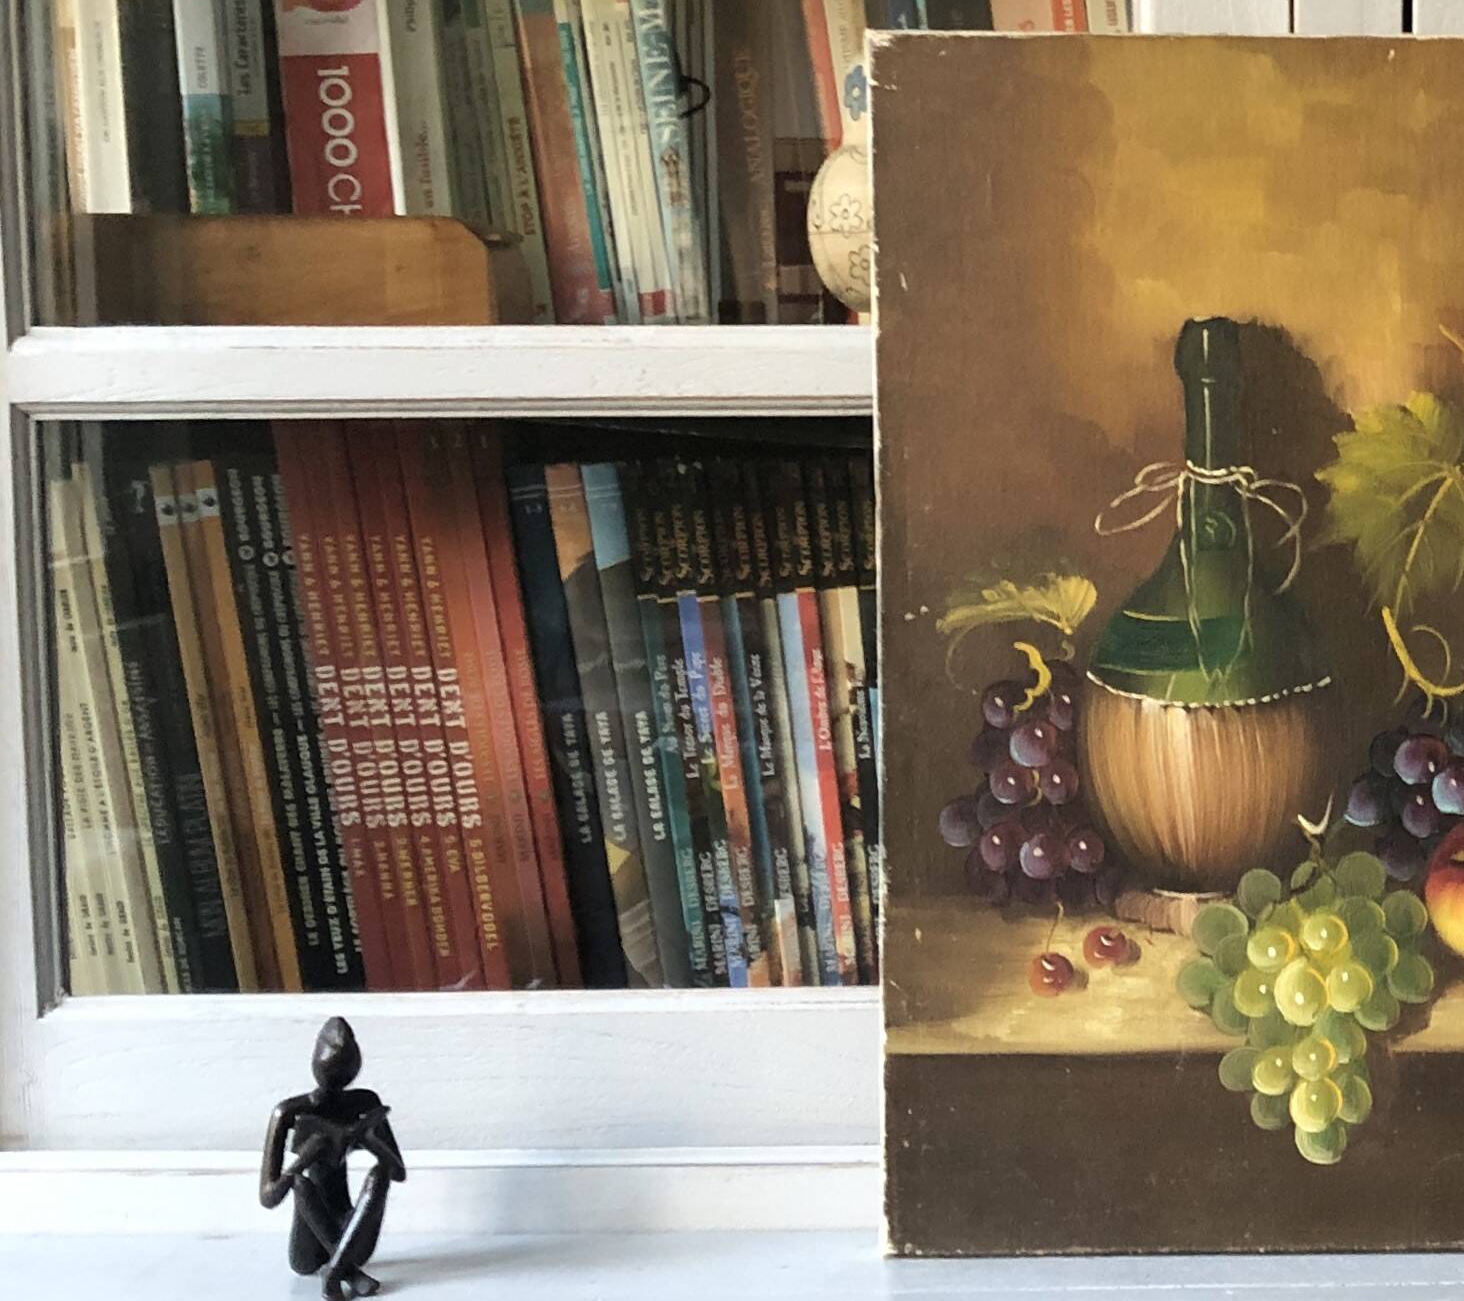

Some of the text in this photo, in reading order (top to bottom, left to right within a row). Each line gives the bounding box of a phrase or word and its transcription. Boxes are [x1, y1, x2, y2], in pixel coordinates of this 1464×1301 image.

[195, 46, 210, 90] COLETTE
[317, 65, 358, 168] 1000
[315, 664, 345, 727] DENT
[339, 667, 370, 729] DENT
[361, 665, 393, 728] DENT
[385, 665, 416, 728] DENT
[410, 665, 442, 728] DENT
[436, 667, 468, 730] DENT
[327, 738, 361, 827] D'OURS
[351, 739, 387, 829] D'OURS
[373, 739, 409, 829] D'OURS
[398, 739, 433, 828] D'OURS
[422, 738, 459, 829] D'OURS
[448, 740, 484, 830] D'OURS
[567, 749, 583, 768] DE
[599, 748, 616, 766] DE
[639, 746, 656, 766] DE
[760, 762, 776, 777] Le
[306, 796, 323, 830] VILLE
[313, 829, 327, 846] LA
[578, 824, 593, 844] LA
[611, 824, 628, 842] LA
[651, 821, 668, 842] LA
[830, 841, 851, 902] DESBERG
[327, 916, 345, 951] YEUX
[680, 847, 709, 971] MARINI DESBERG
[697, 850, 728, 976] MARINI DESBERG
[334, 952, 349, 975] LES
